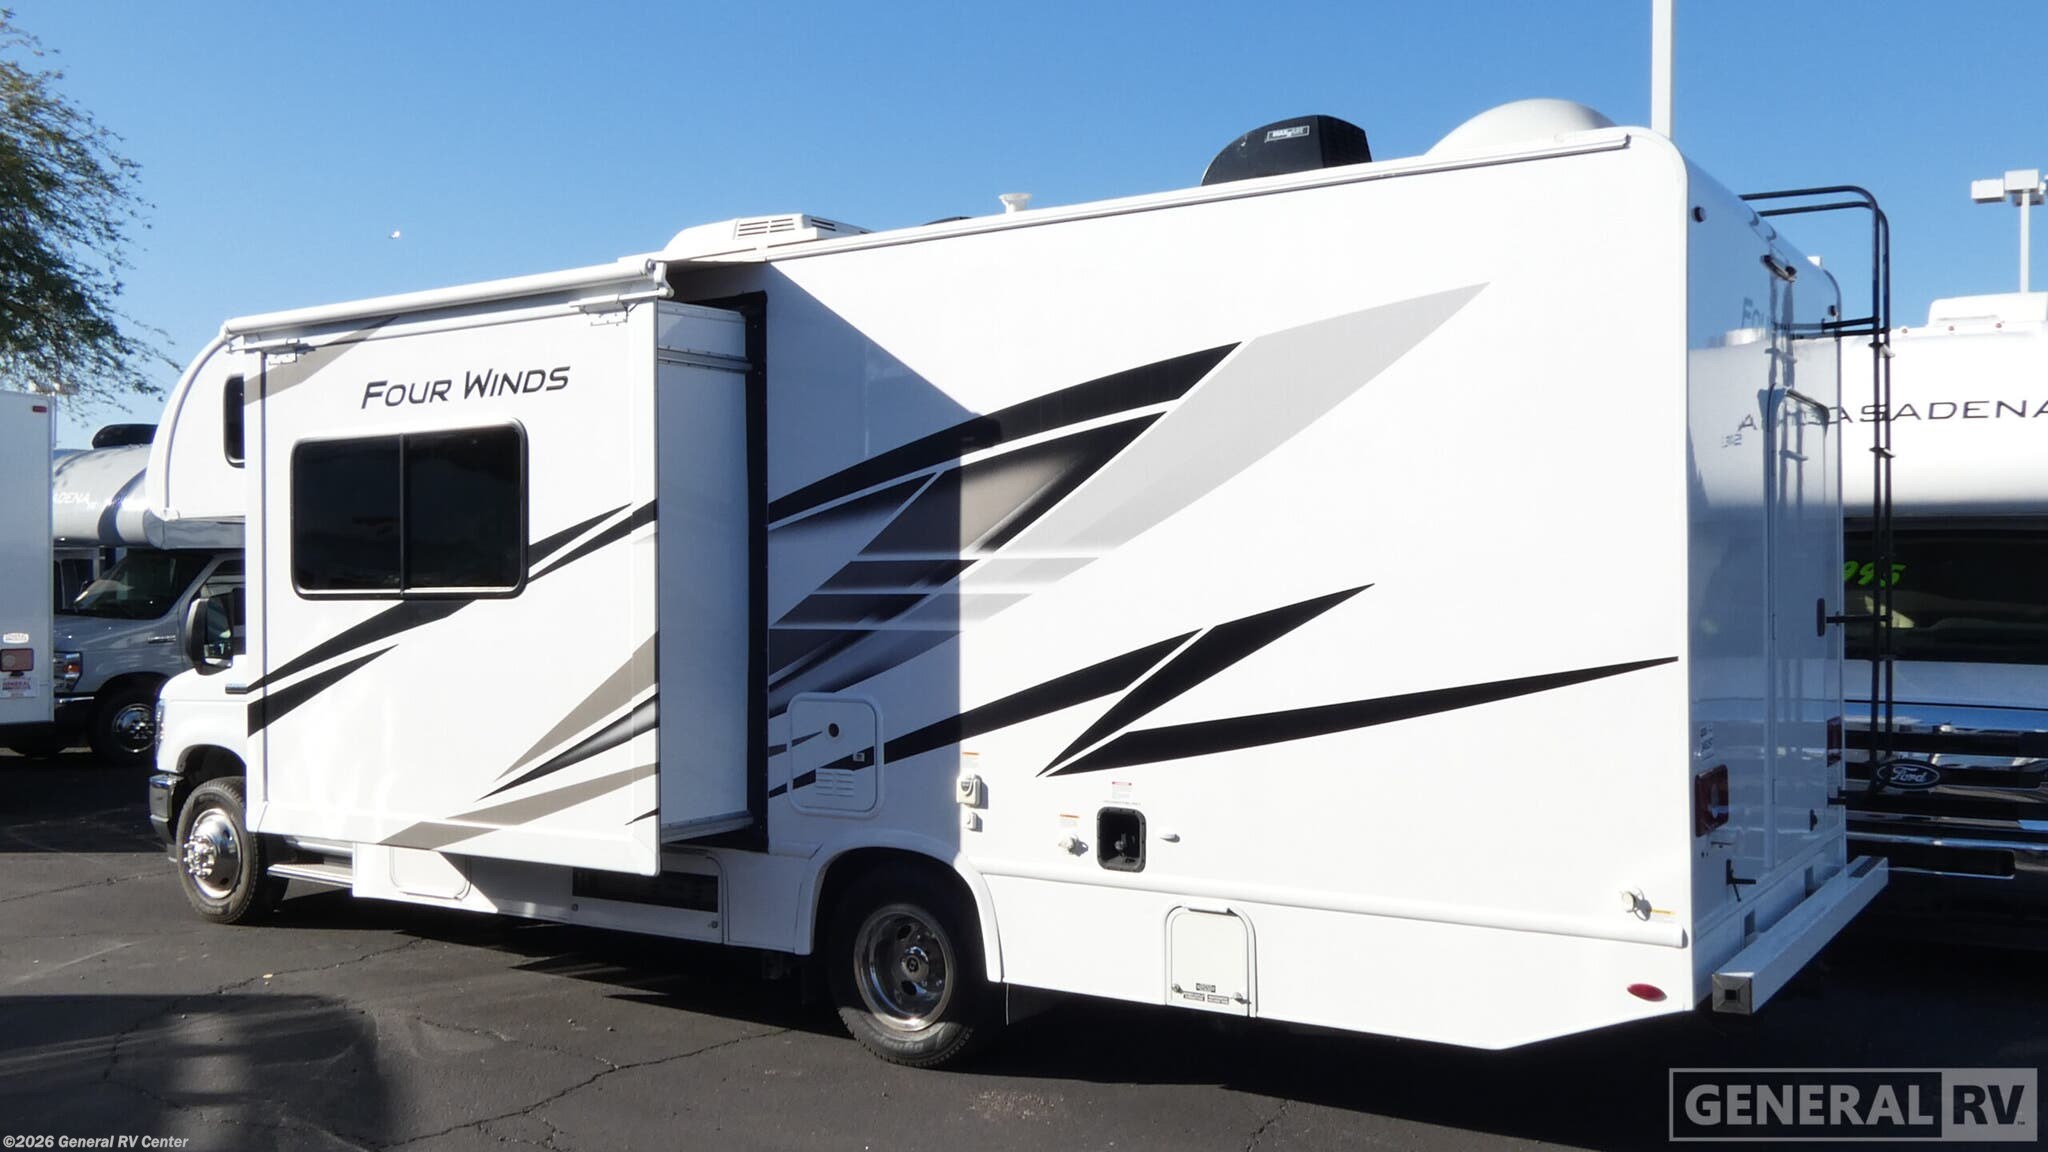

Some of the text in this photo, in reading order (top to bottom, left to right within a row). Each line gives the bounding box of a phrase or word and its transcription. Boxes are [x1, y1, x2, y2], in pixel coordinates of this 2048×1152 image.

[361, 366, 571, 409] FOUR WINDS
[1890, 765, 1928, 783] Ford
